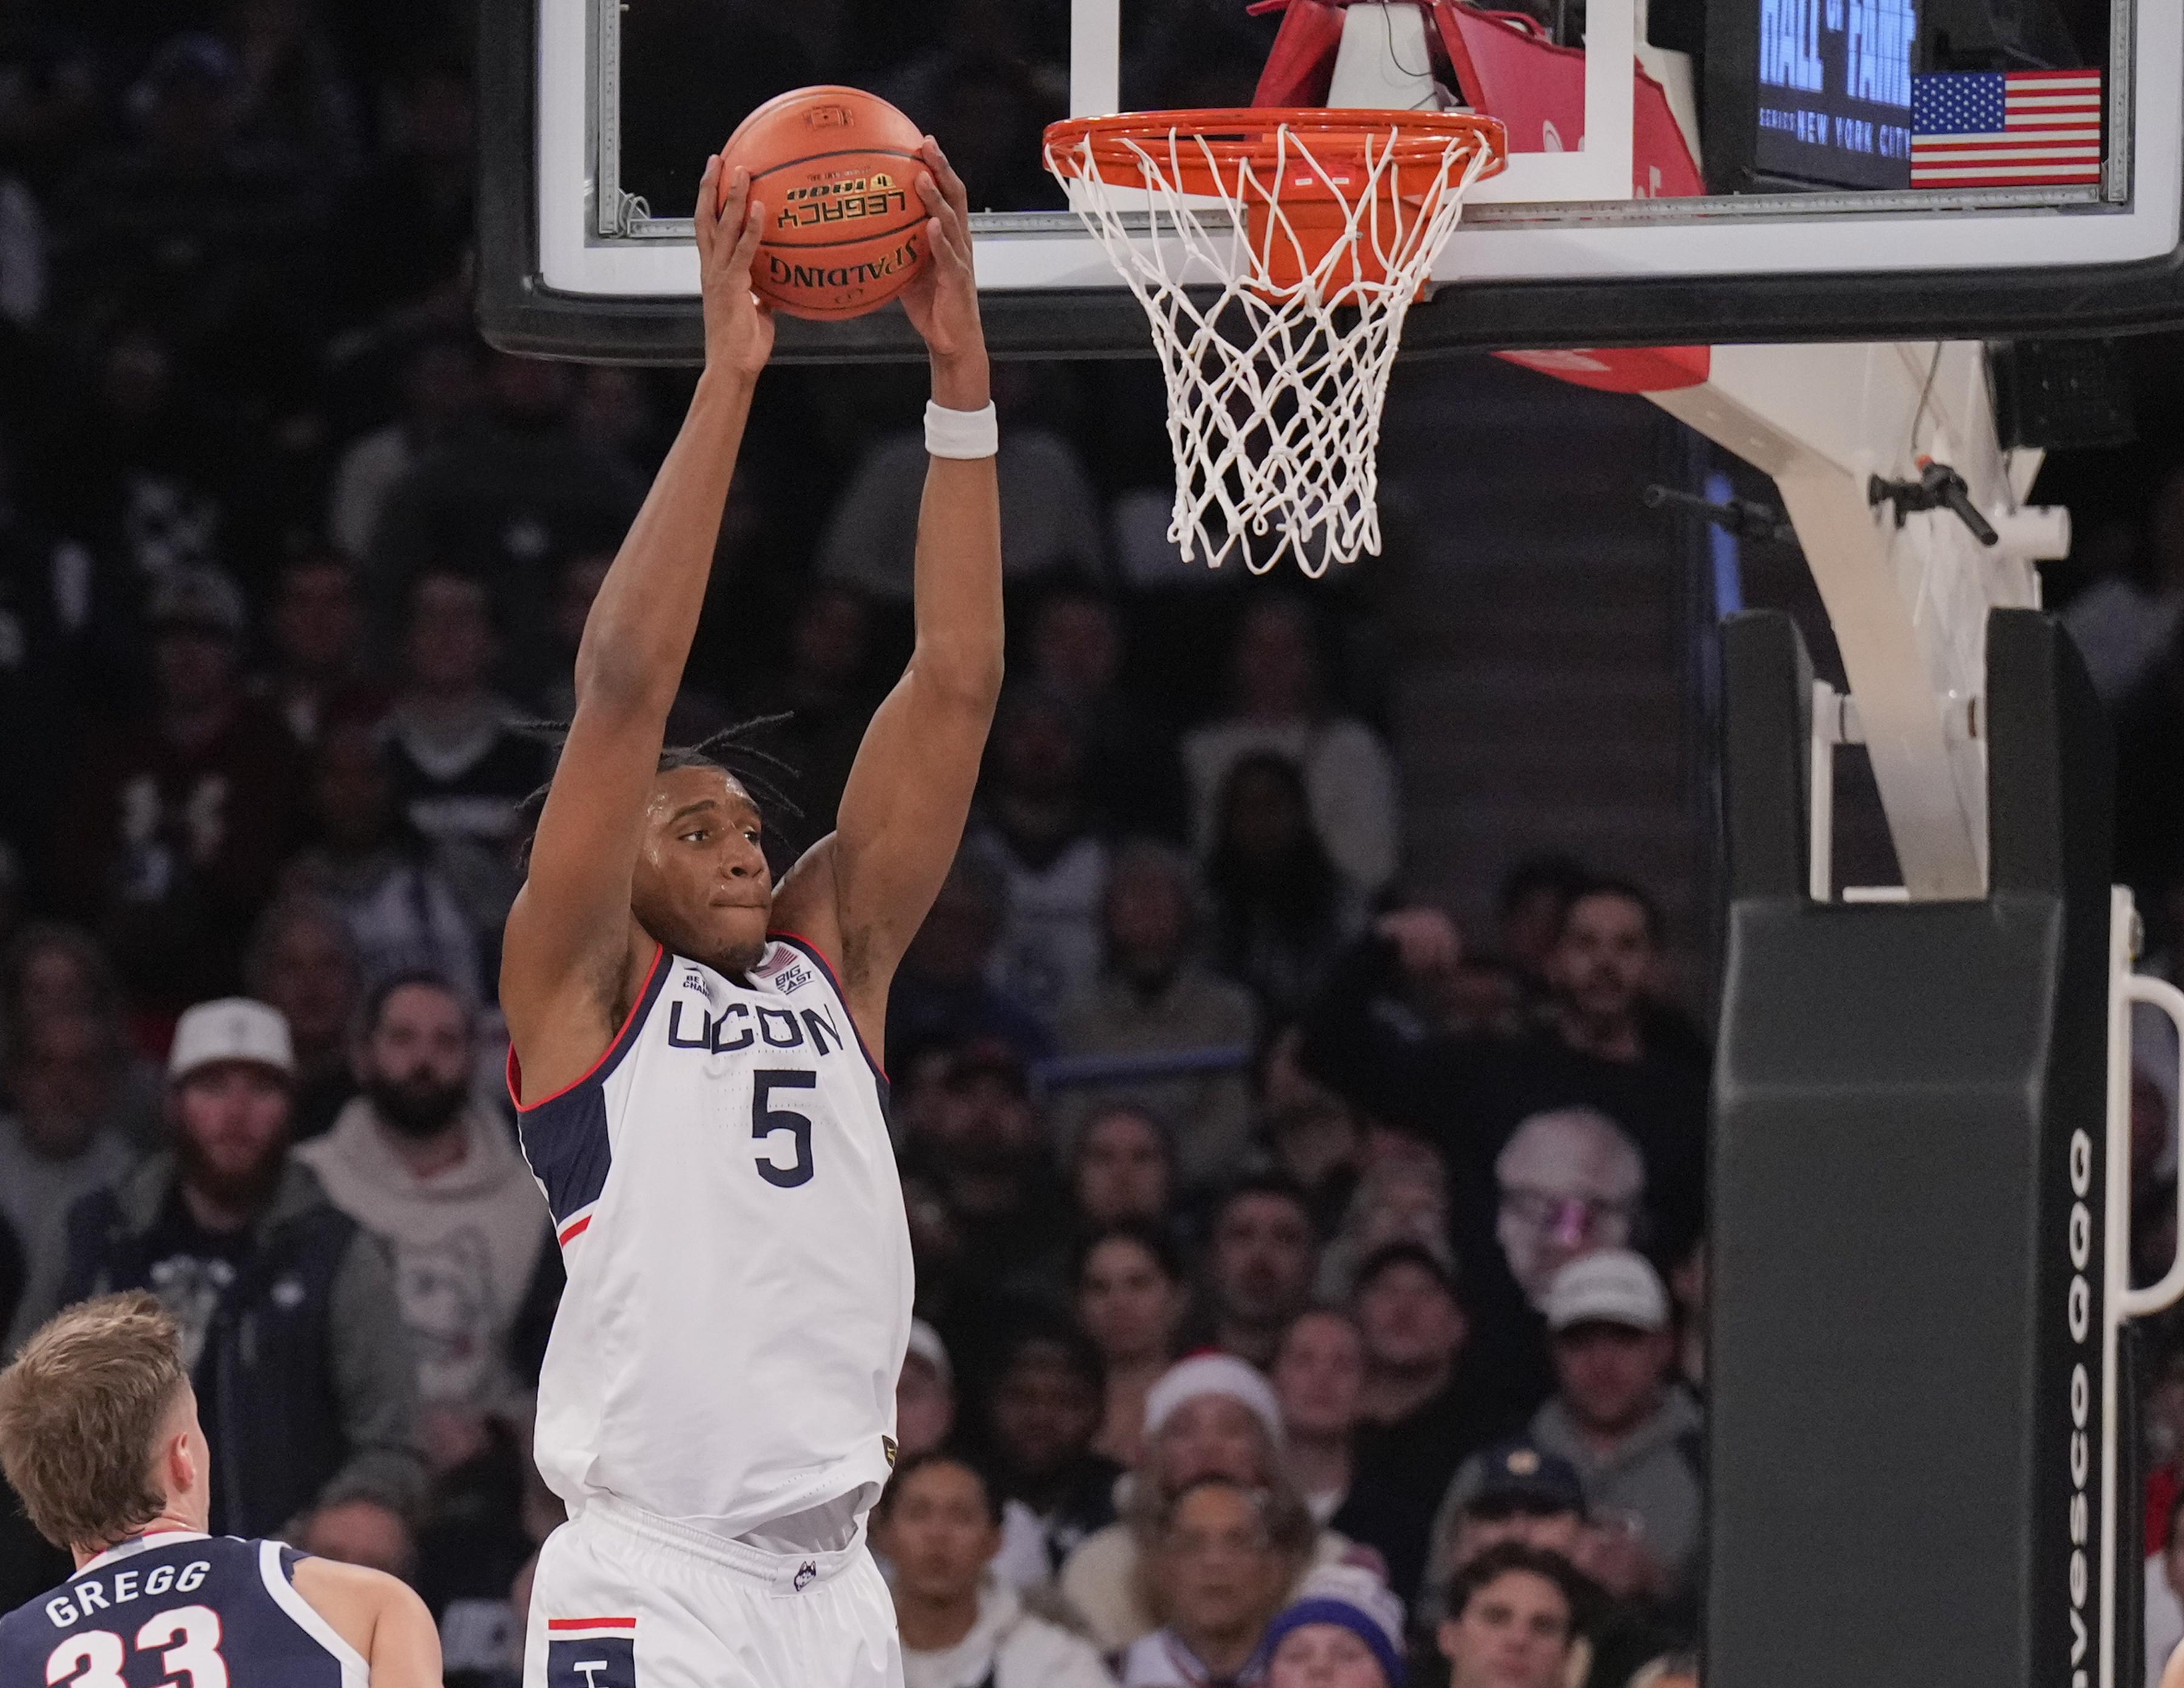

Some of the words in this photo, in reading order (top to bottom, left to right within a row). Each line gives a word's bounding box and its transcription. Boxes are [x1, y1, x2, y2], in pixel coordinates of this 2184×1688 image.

[1798, 110, 1829, 146] NEW
[1835, 116, 1873, 154] YORK
[778, 191, 906, 229] LEGACY
[769, 235, 918, 288] SPALDING
[687, 975, 699, 984] BE
[775, 965, 801, 987] BIG
[752, 1069, 817, 1188] 5
[45, 1561, 211, 1627] GREGG
[45, 1604, 230, 1688] 33
